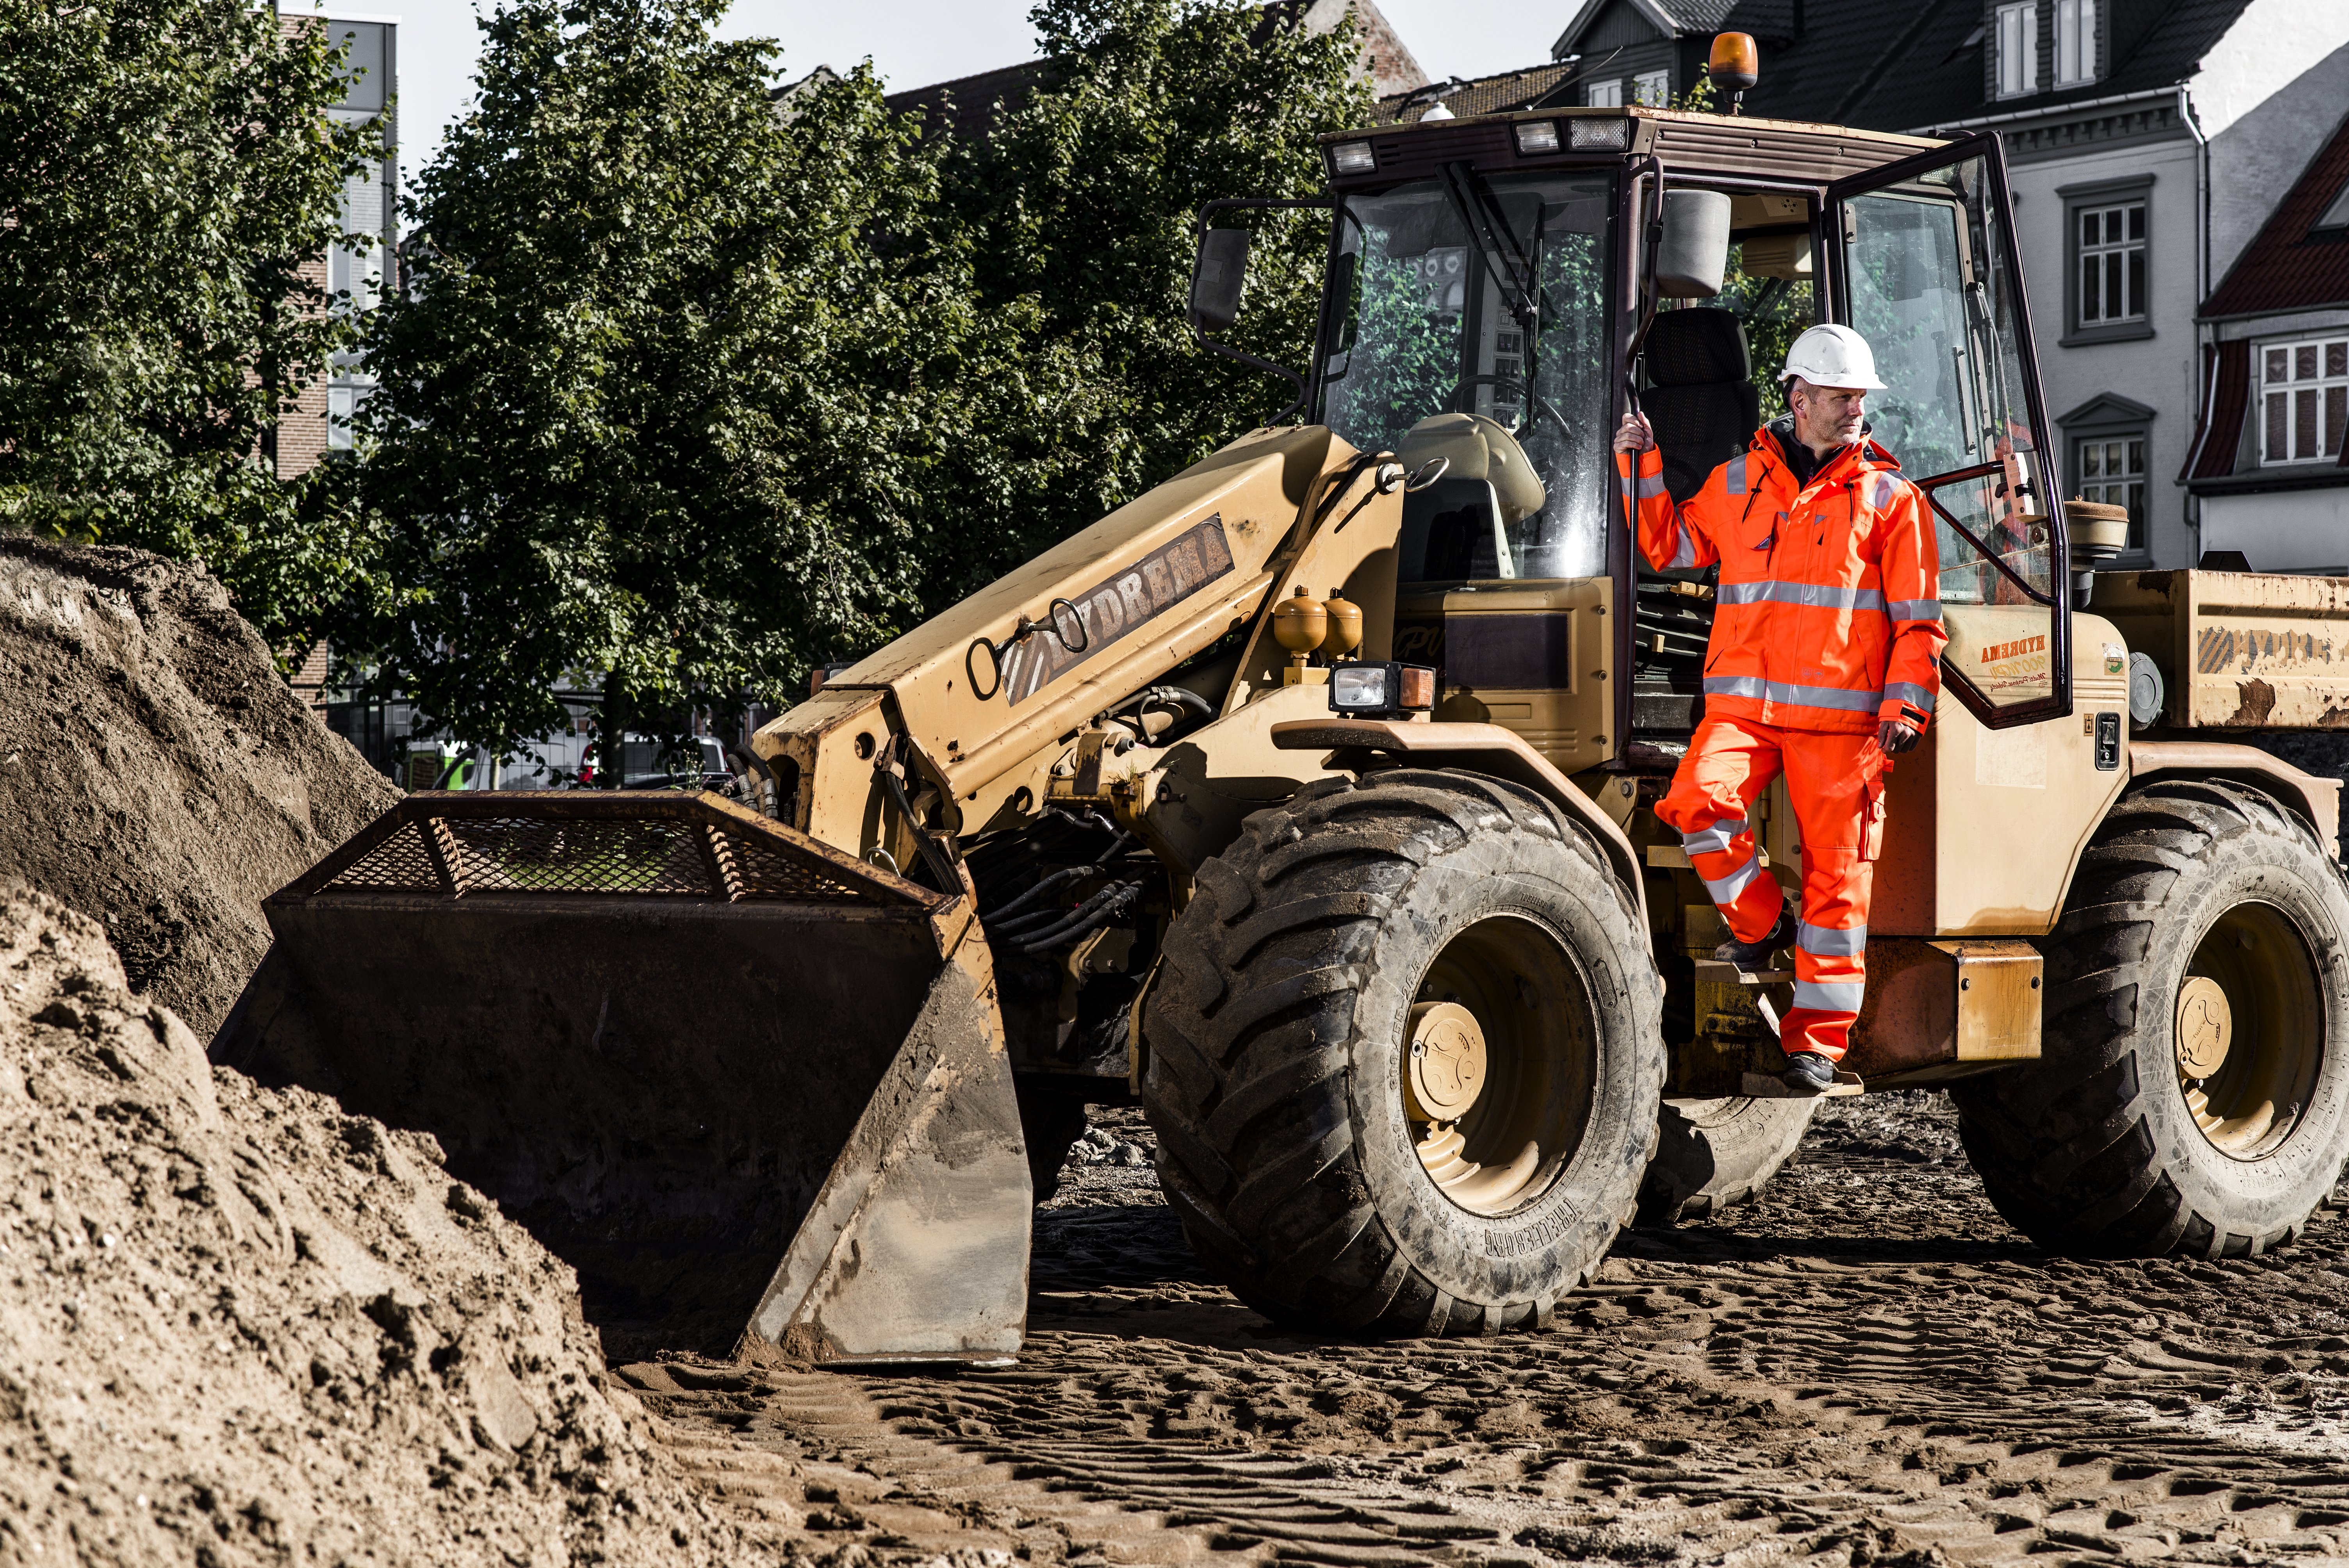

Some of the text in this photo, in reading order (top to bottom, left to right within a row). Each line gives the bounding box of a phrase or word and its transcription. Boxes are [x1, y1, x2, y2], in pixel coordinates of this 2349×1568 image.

[1760, 538, 1769, 546] ENGEL
[1042, 525, 1231, 671] HYDREMA
[1485, 1196, 1582, 1257] TRELLEBORG
